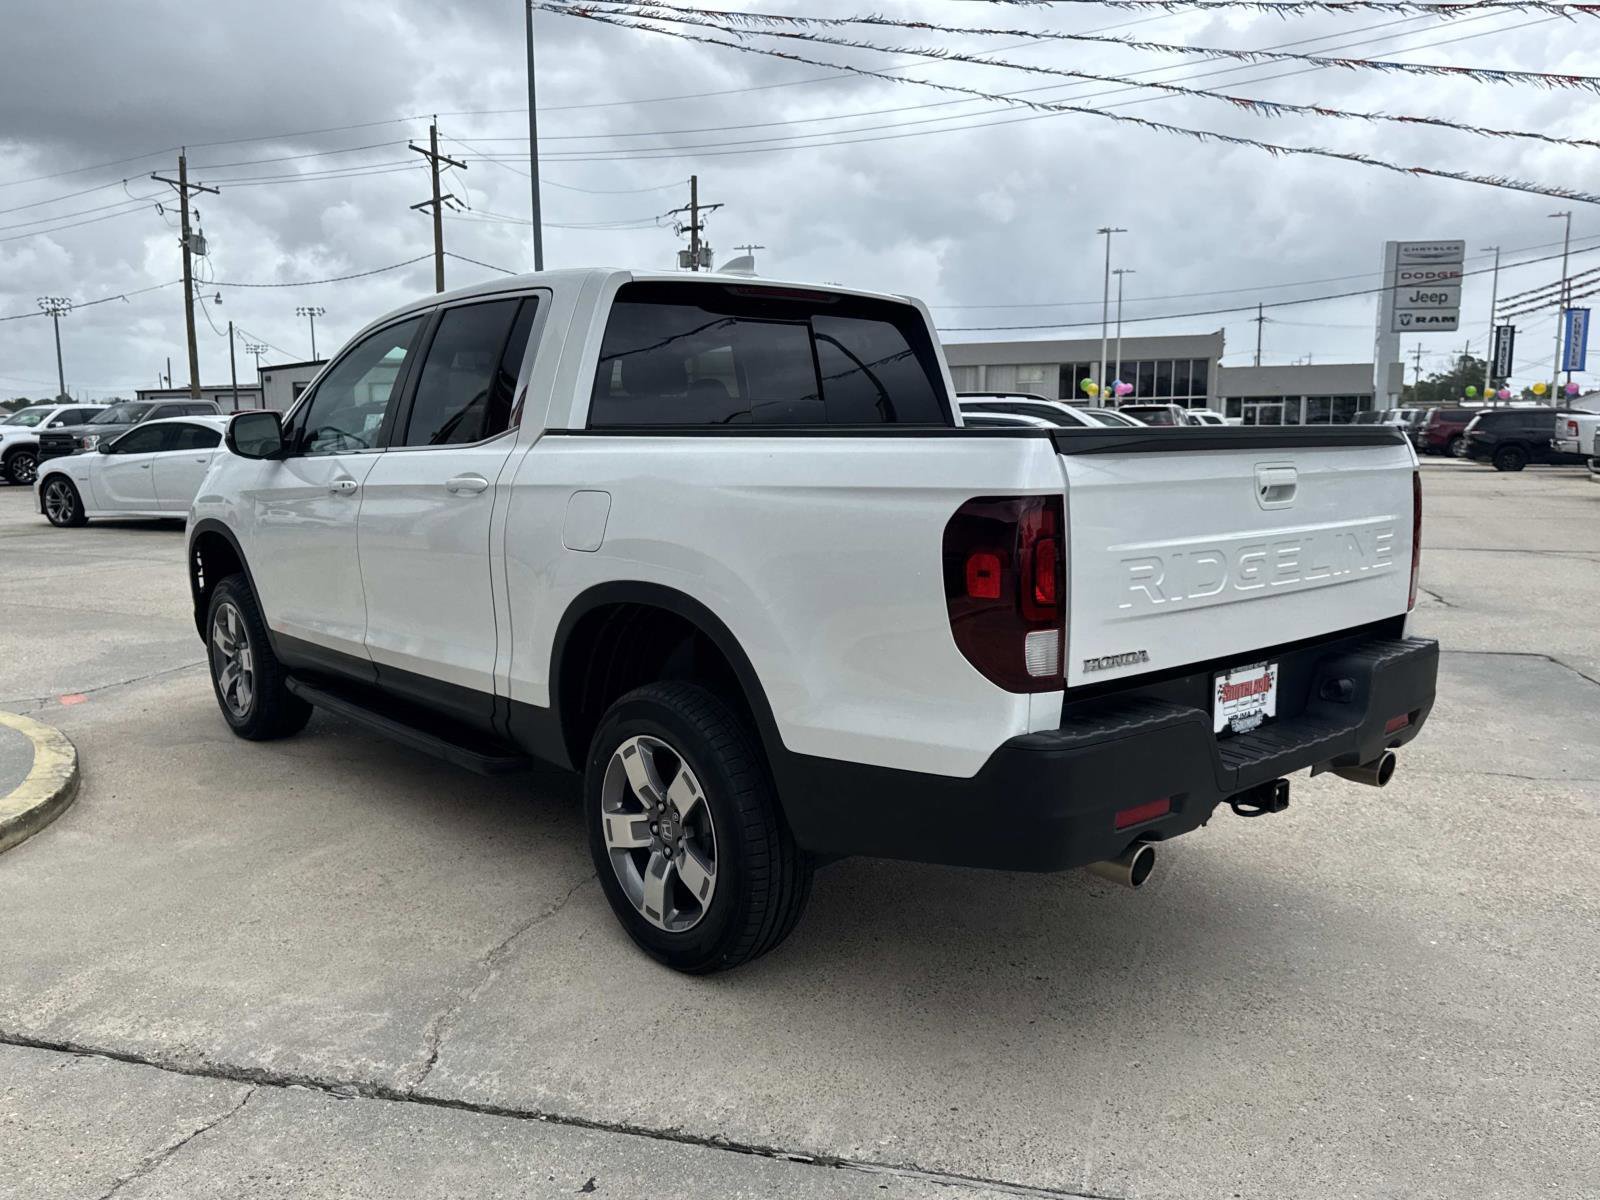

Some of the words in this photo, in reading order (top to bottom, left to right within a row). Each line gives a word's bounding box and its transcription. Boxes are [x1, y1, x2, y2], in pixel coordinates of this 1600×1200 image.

[1401, 271, 1460, 280] DODGE
[1409, 290, 1448, 305] Jeep
[1415, 316, 1457, 324] RAM
[1118, 527, 1395, 609] RIDGELINE
[1082, 649, 1151, 674] HONDA
